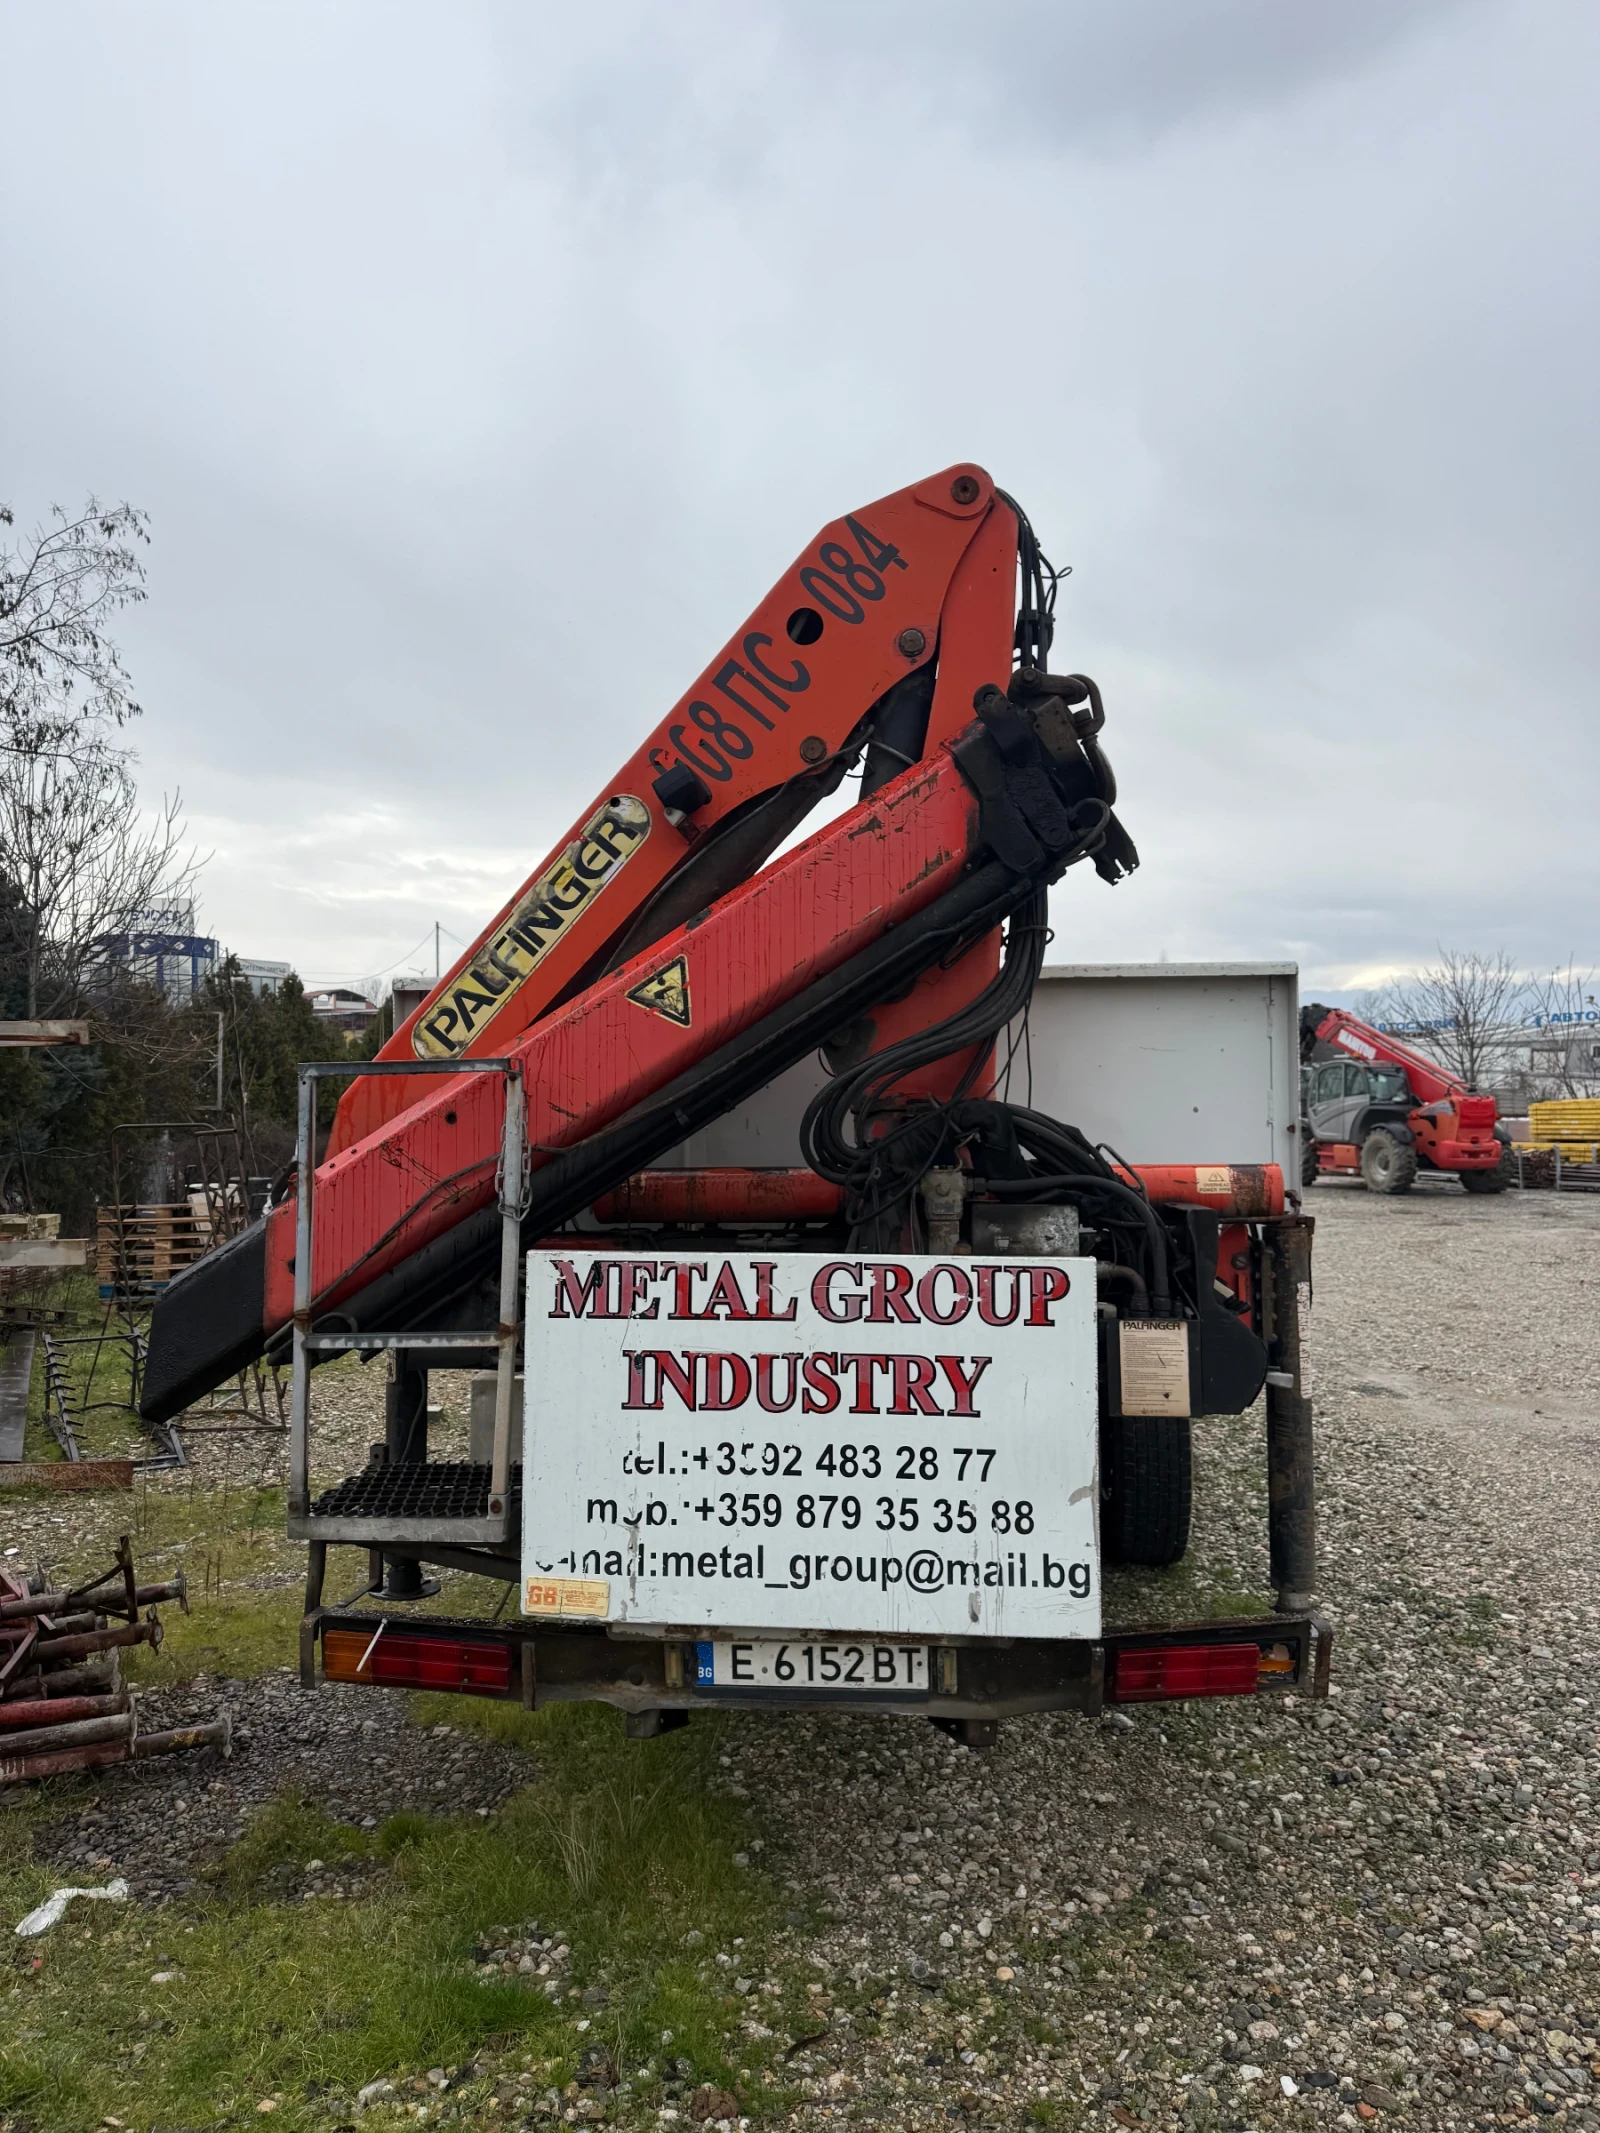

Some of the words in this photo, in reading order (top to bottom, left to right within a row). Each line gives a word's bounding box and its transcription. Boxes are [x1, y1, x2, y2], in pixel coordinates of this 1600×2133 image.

[800, 514, 909, 625] 084
[424, 819, 639, 1052] PALFINGER
[548, 1259, 798, 1321] METAL
[810, 1261, 1071, 1327] GROUP
[621, 1349, 992, 1417] INDUSTRY
[815, 1443, 882, 1479] 483
[895, 1446, 939, 1480] 28
[952, 1447, 997, 1482] 77
[796, 1494, 862, 1529] 879
[875, 1496, 919, 1531] 35
[933, 1498, 977, 1534] 35
[991, 1500, 1035, 1535] 88
[528, 1585, 558, 1606] GB
[535, 1543, 1091, 1599] -mal:metal_group@mail.bg
[697, 1666, 713, 1678] BG
